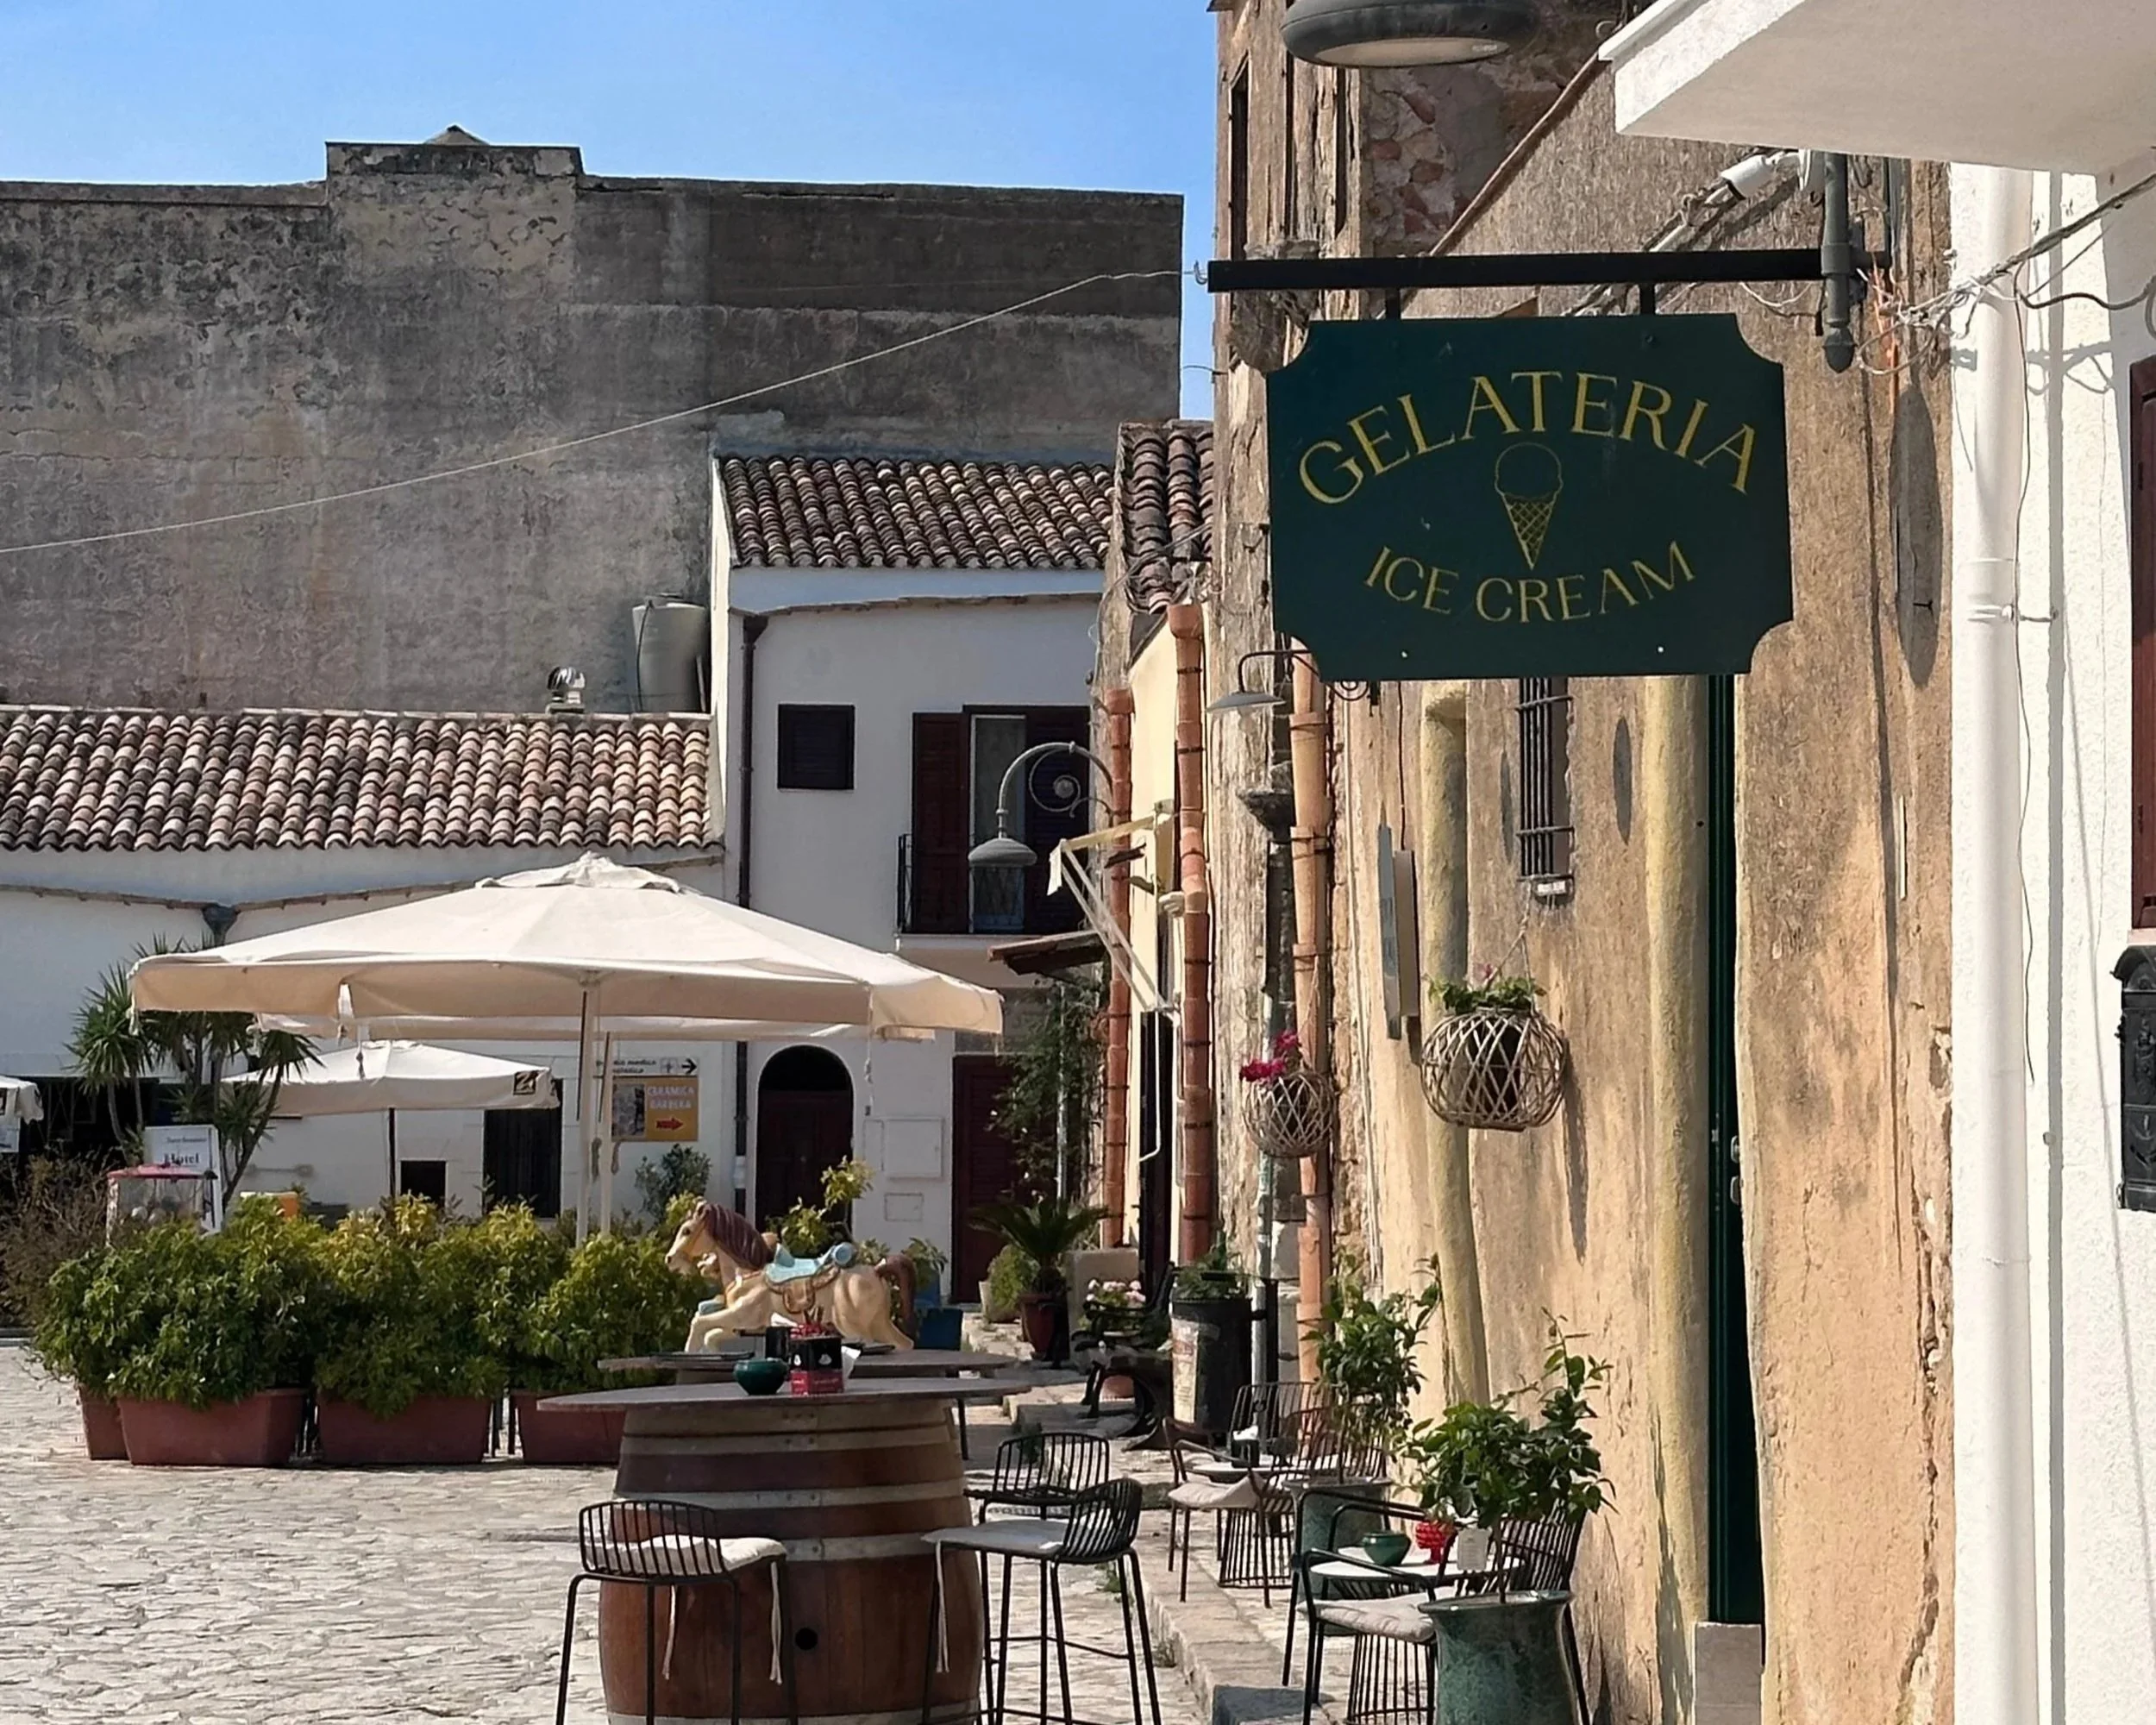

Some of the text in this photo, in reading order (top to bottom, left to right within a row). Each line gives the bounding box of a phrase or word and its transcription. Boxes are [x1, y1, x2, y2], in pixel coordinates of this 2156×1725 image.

[1298, 371, 1757, 505] GELATERIA
[1363, 540, 1696, 624] ICE CREAM
